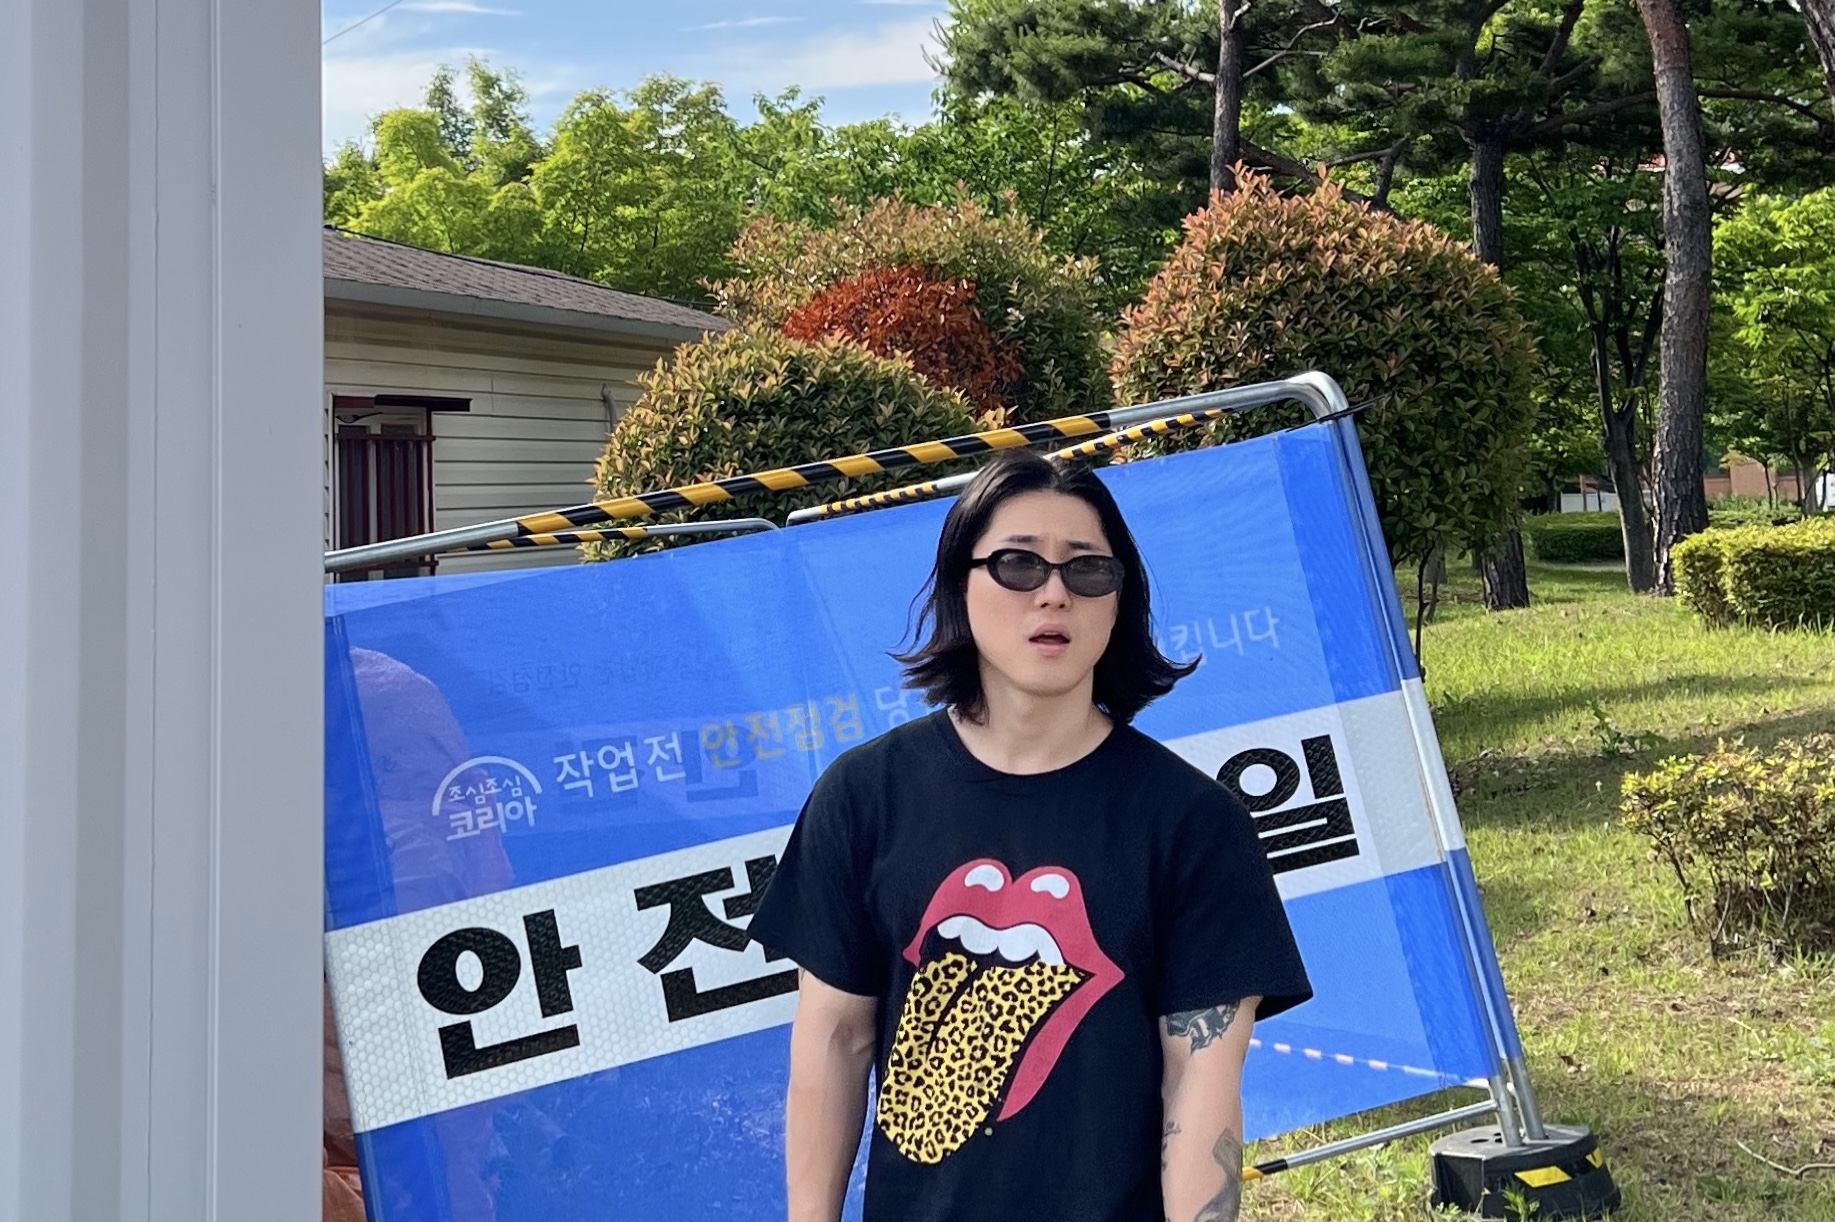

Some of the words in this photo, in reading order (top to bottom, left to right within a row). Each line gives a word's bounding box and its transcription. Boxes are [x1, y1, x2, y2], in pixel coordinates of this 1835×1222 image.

[701, 693, 863, 769] 안전점검
[1160, 604, 1280, 664] 킵니다
[448, 774, 522, 805] 조심조심
[446, 796, 538, 842] 코리아
